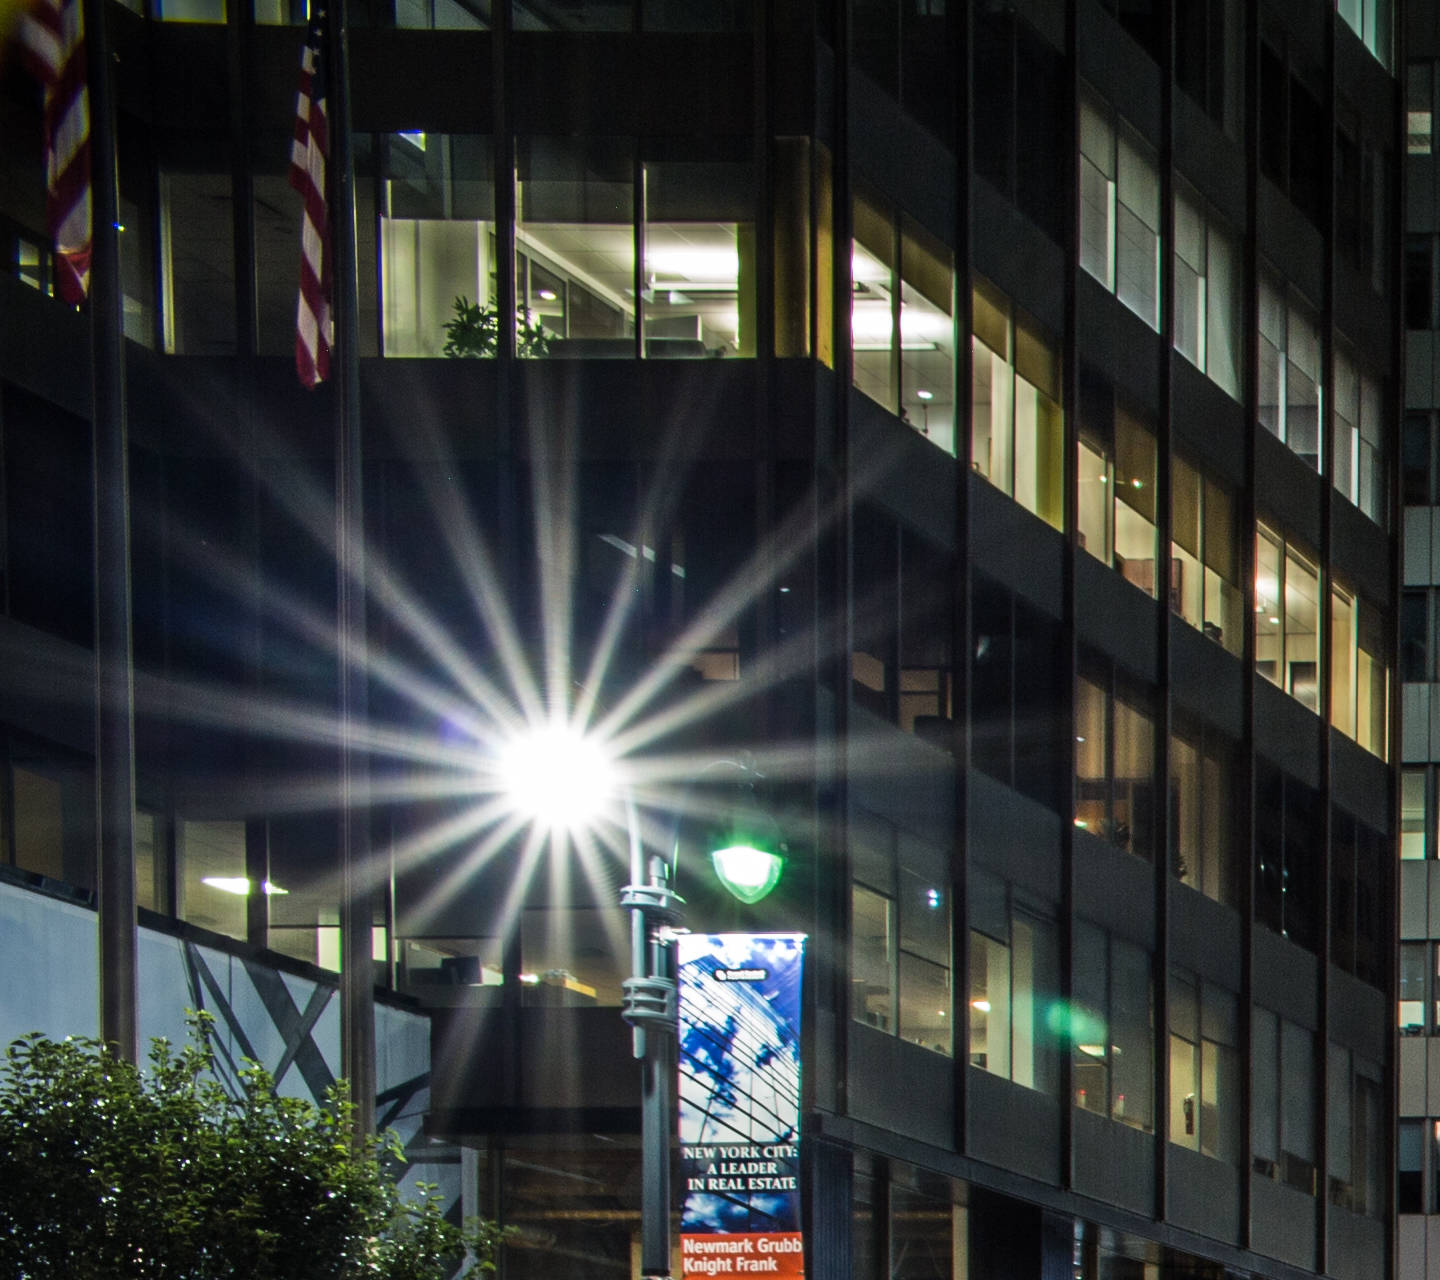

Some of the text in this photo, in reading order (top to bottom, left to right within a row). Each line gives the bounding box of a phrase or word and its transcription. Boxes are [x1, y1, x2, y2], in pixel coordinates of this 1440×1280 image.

[683, 1146, 799, 1159] NEW YORK CITY:
[707, 1162, 778, 1175] A LEADER
[688, 1177, 797, 1190] IN REAL ESTATE
[683, 1237, 802, 1253] Newmark Grubb
[683, 1256, 778, 1276] Knight Frank
